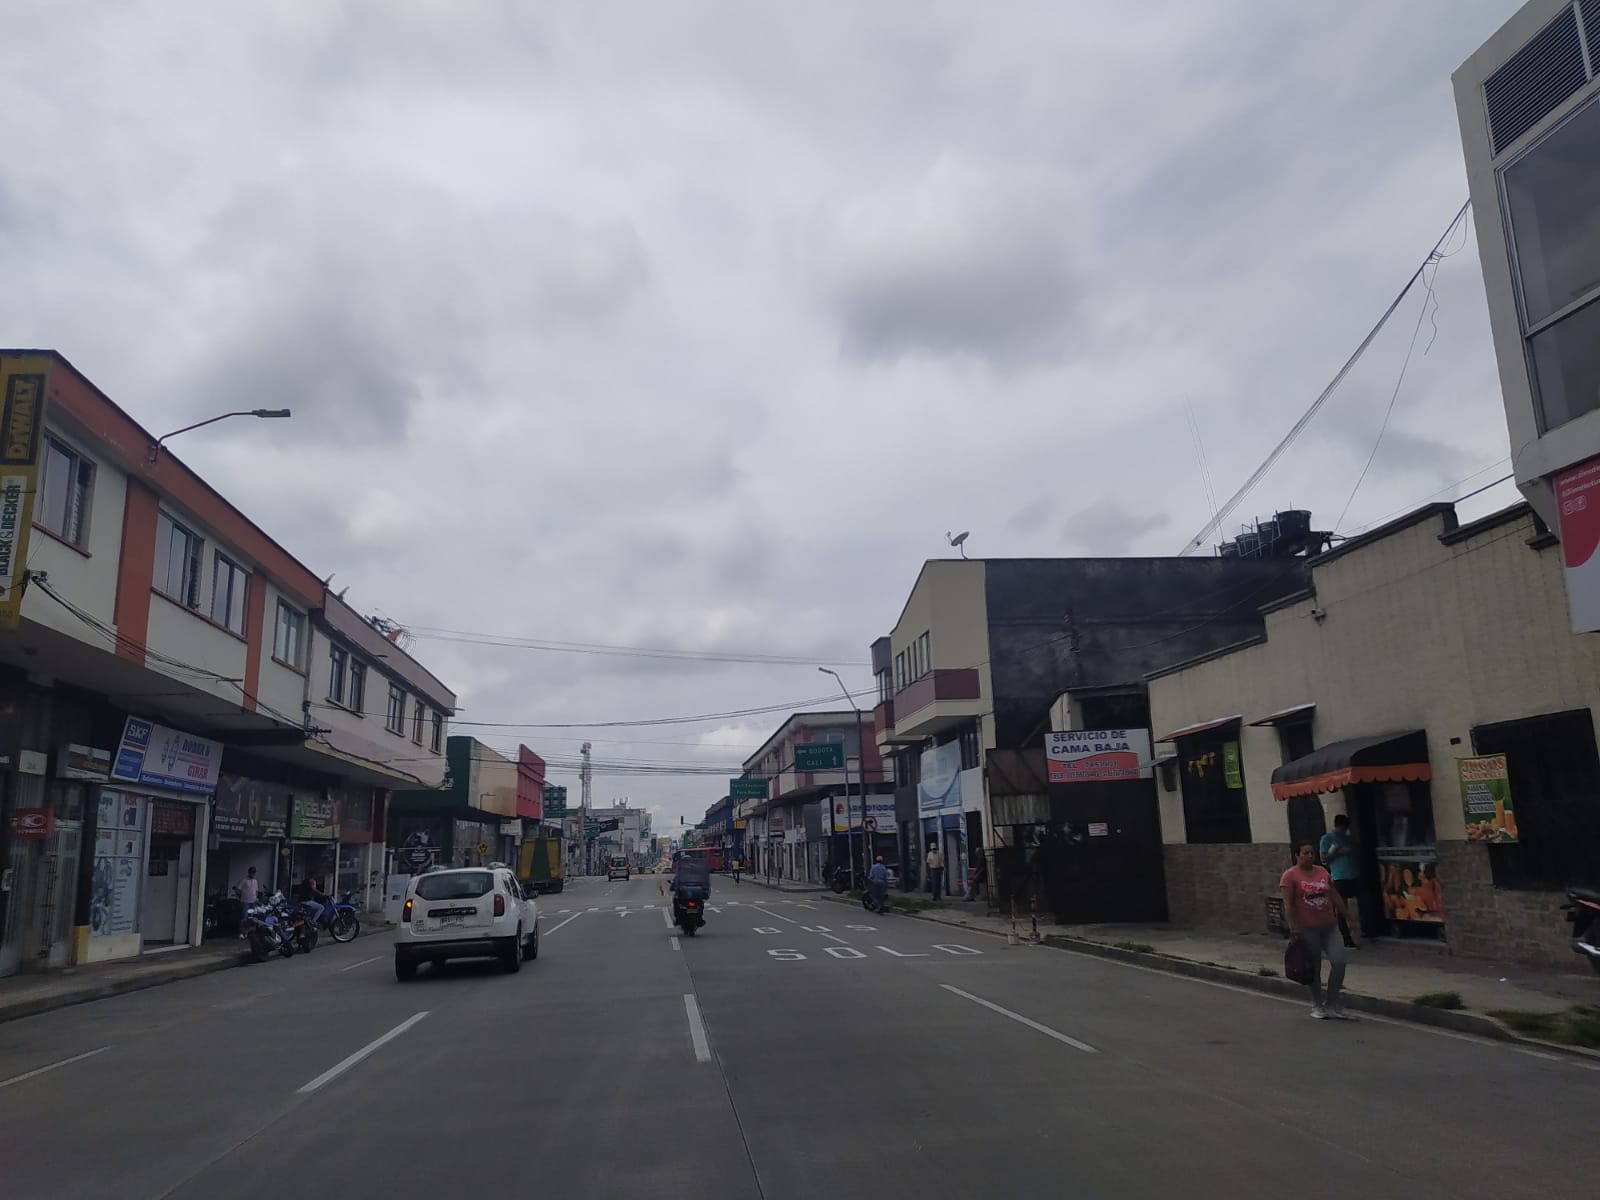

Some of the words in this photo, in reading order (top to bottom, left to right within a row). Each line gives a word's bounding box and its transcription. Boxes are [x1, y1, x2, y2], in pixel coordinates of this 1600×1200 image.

[128, 724, 149, 739] SKF
[1053, 732, 1108, 742] SERVICIO
[1111, 730, 1127, 739] DE
[1052, 744, 1090, 754] CAMA
[1095, 742, 1129, 752] BAJA
[1462, 757, 1505, 772] JUGOS
[752, 924, 880, 934] BUS
[767, 943, 985, 961] SOLO
